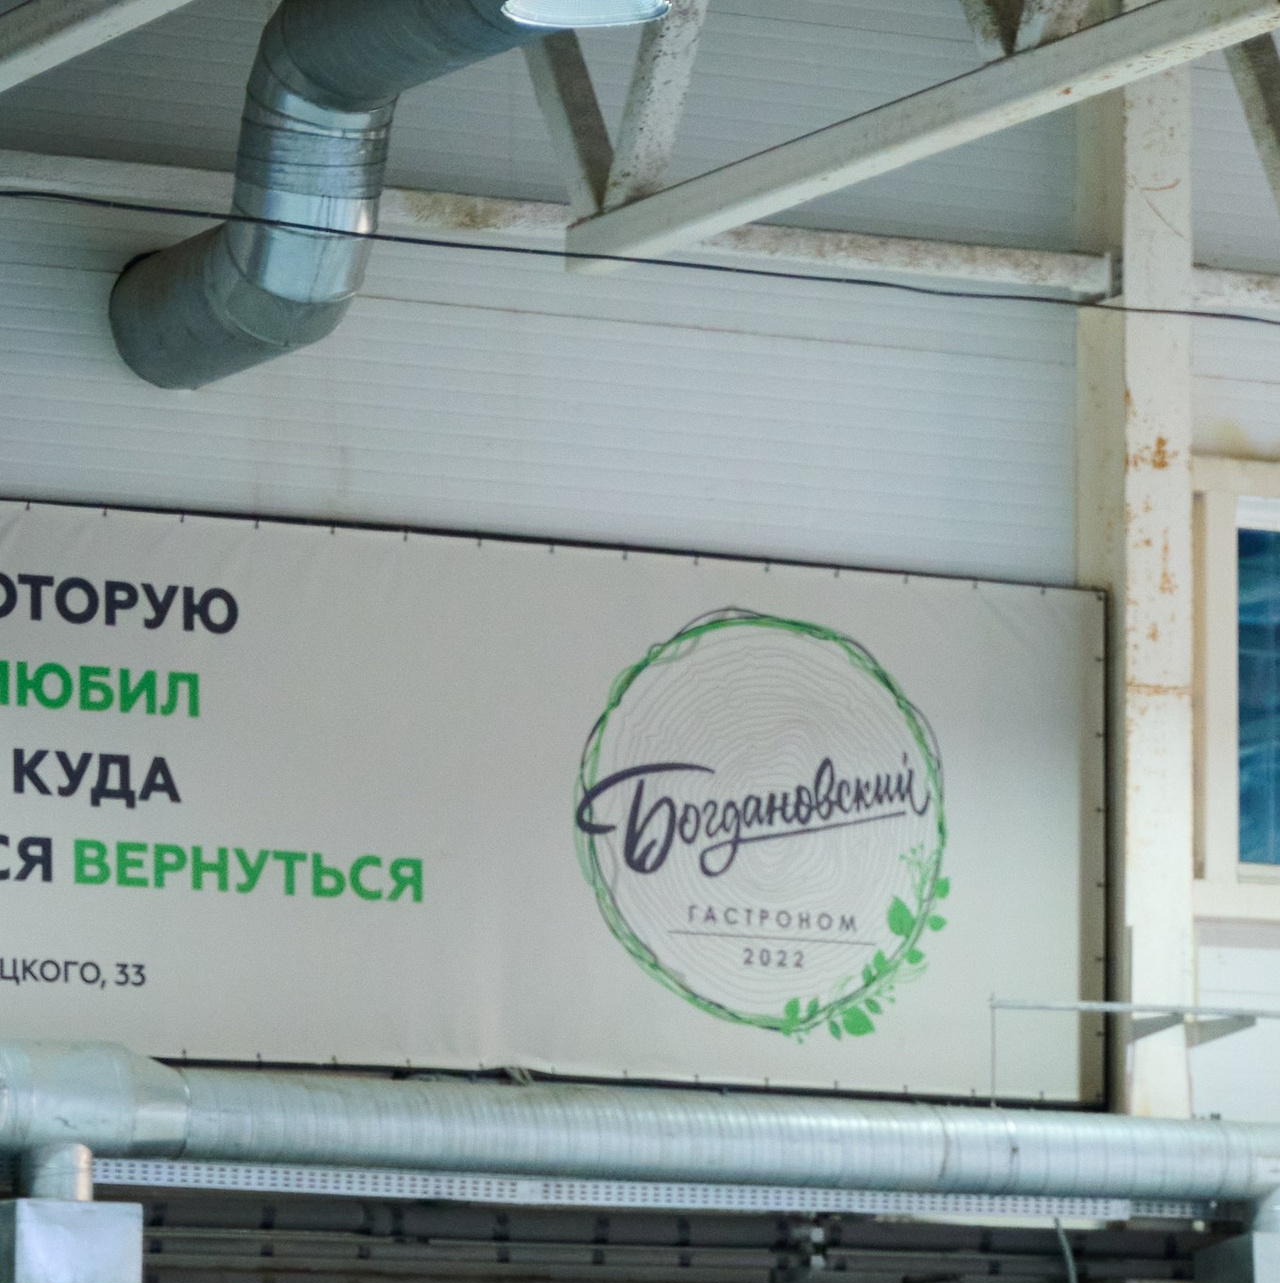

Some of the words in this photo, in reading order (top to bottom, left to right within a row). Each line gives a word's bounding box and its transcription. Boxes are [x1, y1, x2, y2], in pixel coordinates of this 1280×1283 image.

[12, 748, 182, 809] КУДА
[575, 752, 931, 878] Богдановский
[74, 838, 424, 903] ВЕРНУТЬСЯ
[687, 903, 858, 933] ГАСТРОНОМ
[114, 962, 146, 987] 33
[742, 947, 806, 968] 2022
